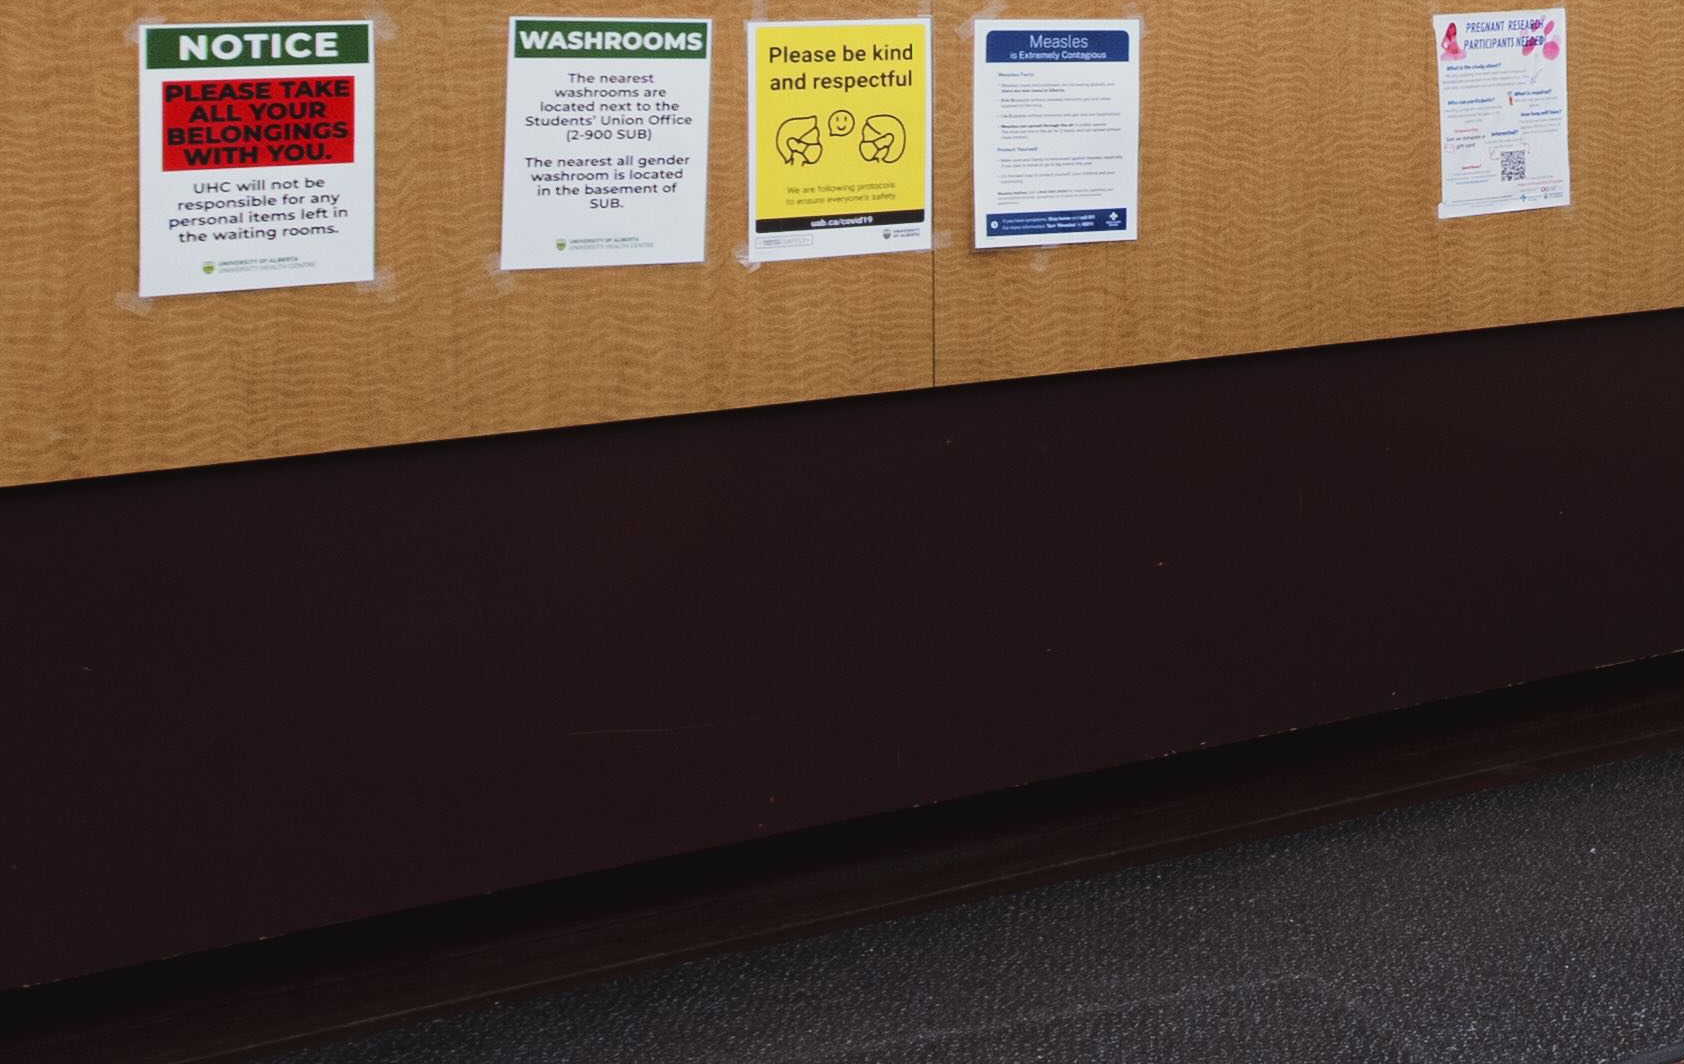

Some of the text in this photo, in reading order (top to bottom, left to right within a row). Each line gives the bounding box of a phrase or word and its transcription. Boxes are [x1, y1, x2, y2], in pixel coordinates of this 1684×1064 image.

[1466, 19, 1545, 33] PREGNANT RESEARCH
[179, 32, 338, 61] NOTICE
[519, 30, 703, 51] WASHROOMS
[1029, 34, 1089, 49] Measles
[1464, 35, 1545, 50] PARTICIPANTS NEEDED
[769, 43, 913, 64] Please be kind
[1009, 50, 1107, 61] is Extremely Contagious
[568, 73, 654, 84] The nearest
[770, 70, 912, 92] and respectful
[165, 80, 350, 102] PLEASE TAKE
[554, 88, 667, 98] washrooms are
[189, 102, 326, 123] ALL YOUR
[540, 101, 680, 112] located next to the
[600, 115, 643, 126] Union
[648, 114, 692, 126] Office
[167, 122, 348, 146] BELONGINGS
[566, 129, 652, 142] (2-900 SUB)
[184, 143, 332, 166] WITH YOU.
[525, 155, 690, 169] The nearest all gender
[531, 169, 683, 181] washroom is located
[193, 177, 325, 194] UHC will not be
[537, 183, 677, 196] in the basement of
[817, 184, 856, 193] following
[178, 193, 340, 212] responsible for any
[589, 199, 624, 209] SUB.
[872, 193, 896, 202] safety
[169, 207, 348, 230] personal items left in
[179, 225, 339, 243] the waiting rooms.
